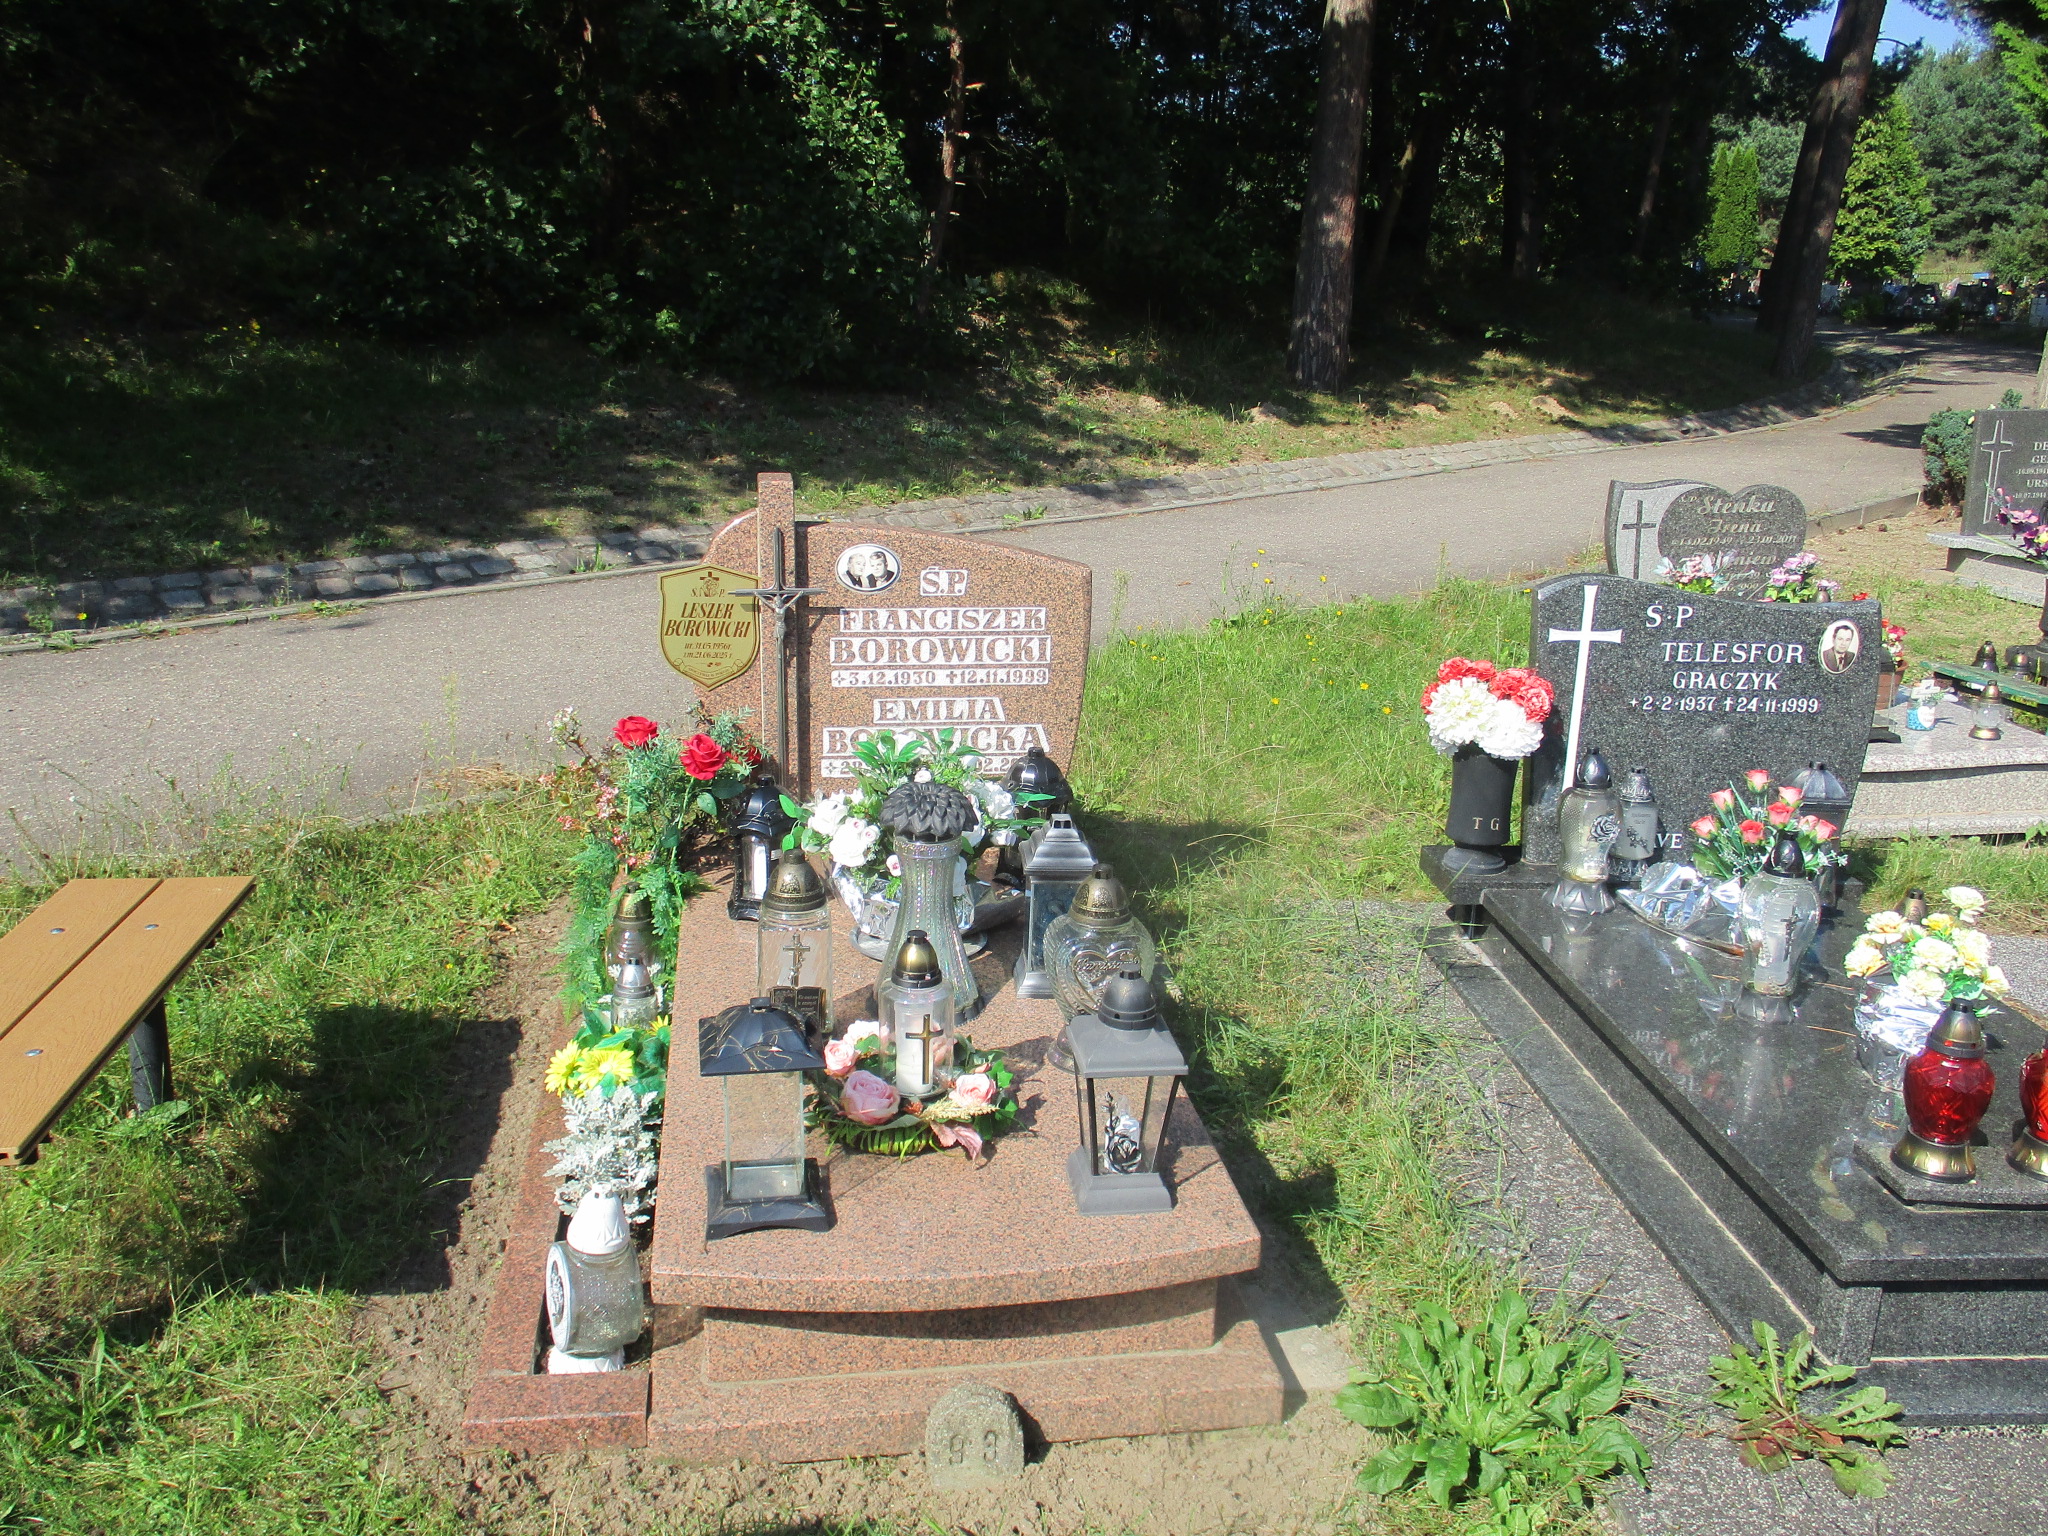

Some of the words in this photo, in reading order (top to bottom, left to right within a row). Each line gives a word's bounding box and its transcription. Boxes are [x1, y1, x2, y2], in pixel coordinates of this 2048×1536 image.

[1697, 494, 1776, 515] Stenka
[681, 602, 734, 619] LESZEK
[842, 609, 1043, 630] FRANCISZEK
[665, 620, 751, 637] BOROWICKI
[831, 637, 1050, 663] BOROWICKI
[1661, 642, 1804, 663] TELESFOR
[849, 670, 936, 685] 3.12.1930
[960, 669, 1047, 684] 12.11.1999
[1673, 671, 1780, 690] GRACZYK
[876, 699, 1001, 721] EMILIA
[827, 726, 1042, 754] BOWICKA
[1654, 833, 1683, 849] VE
